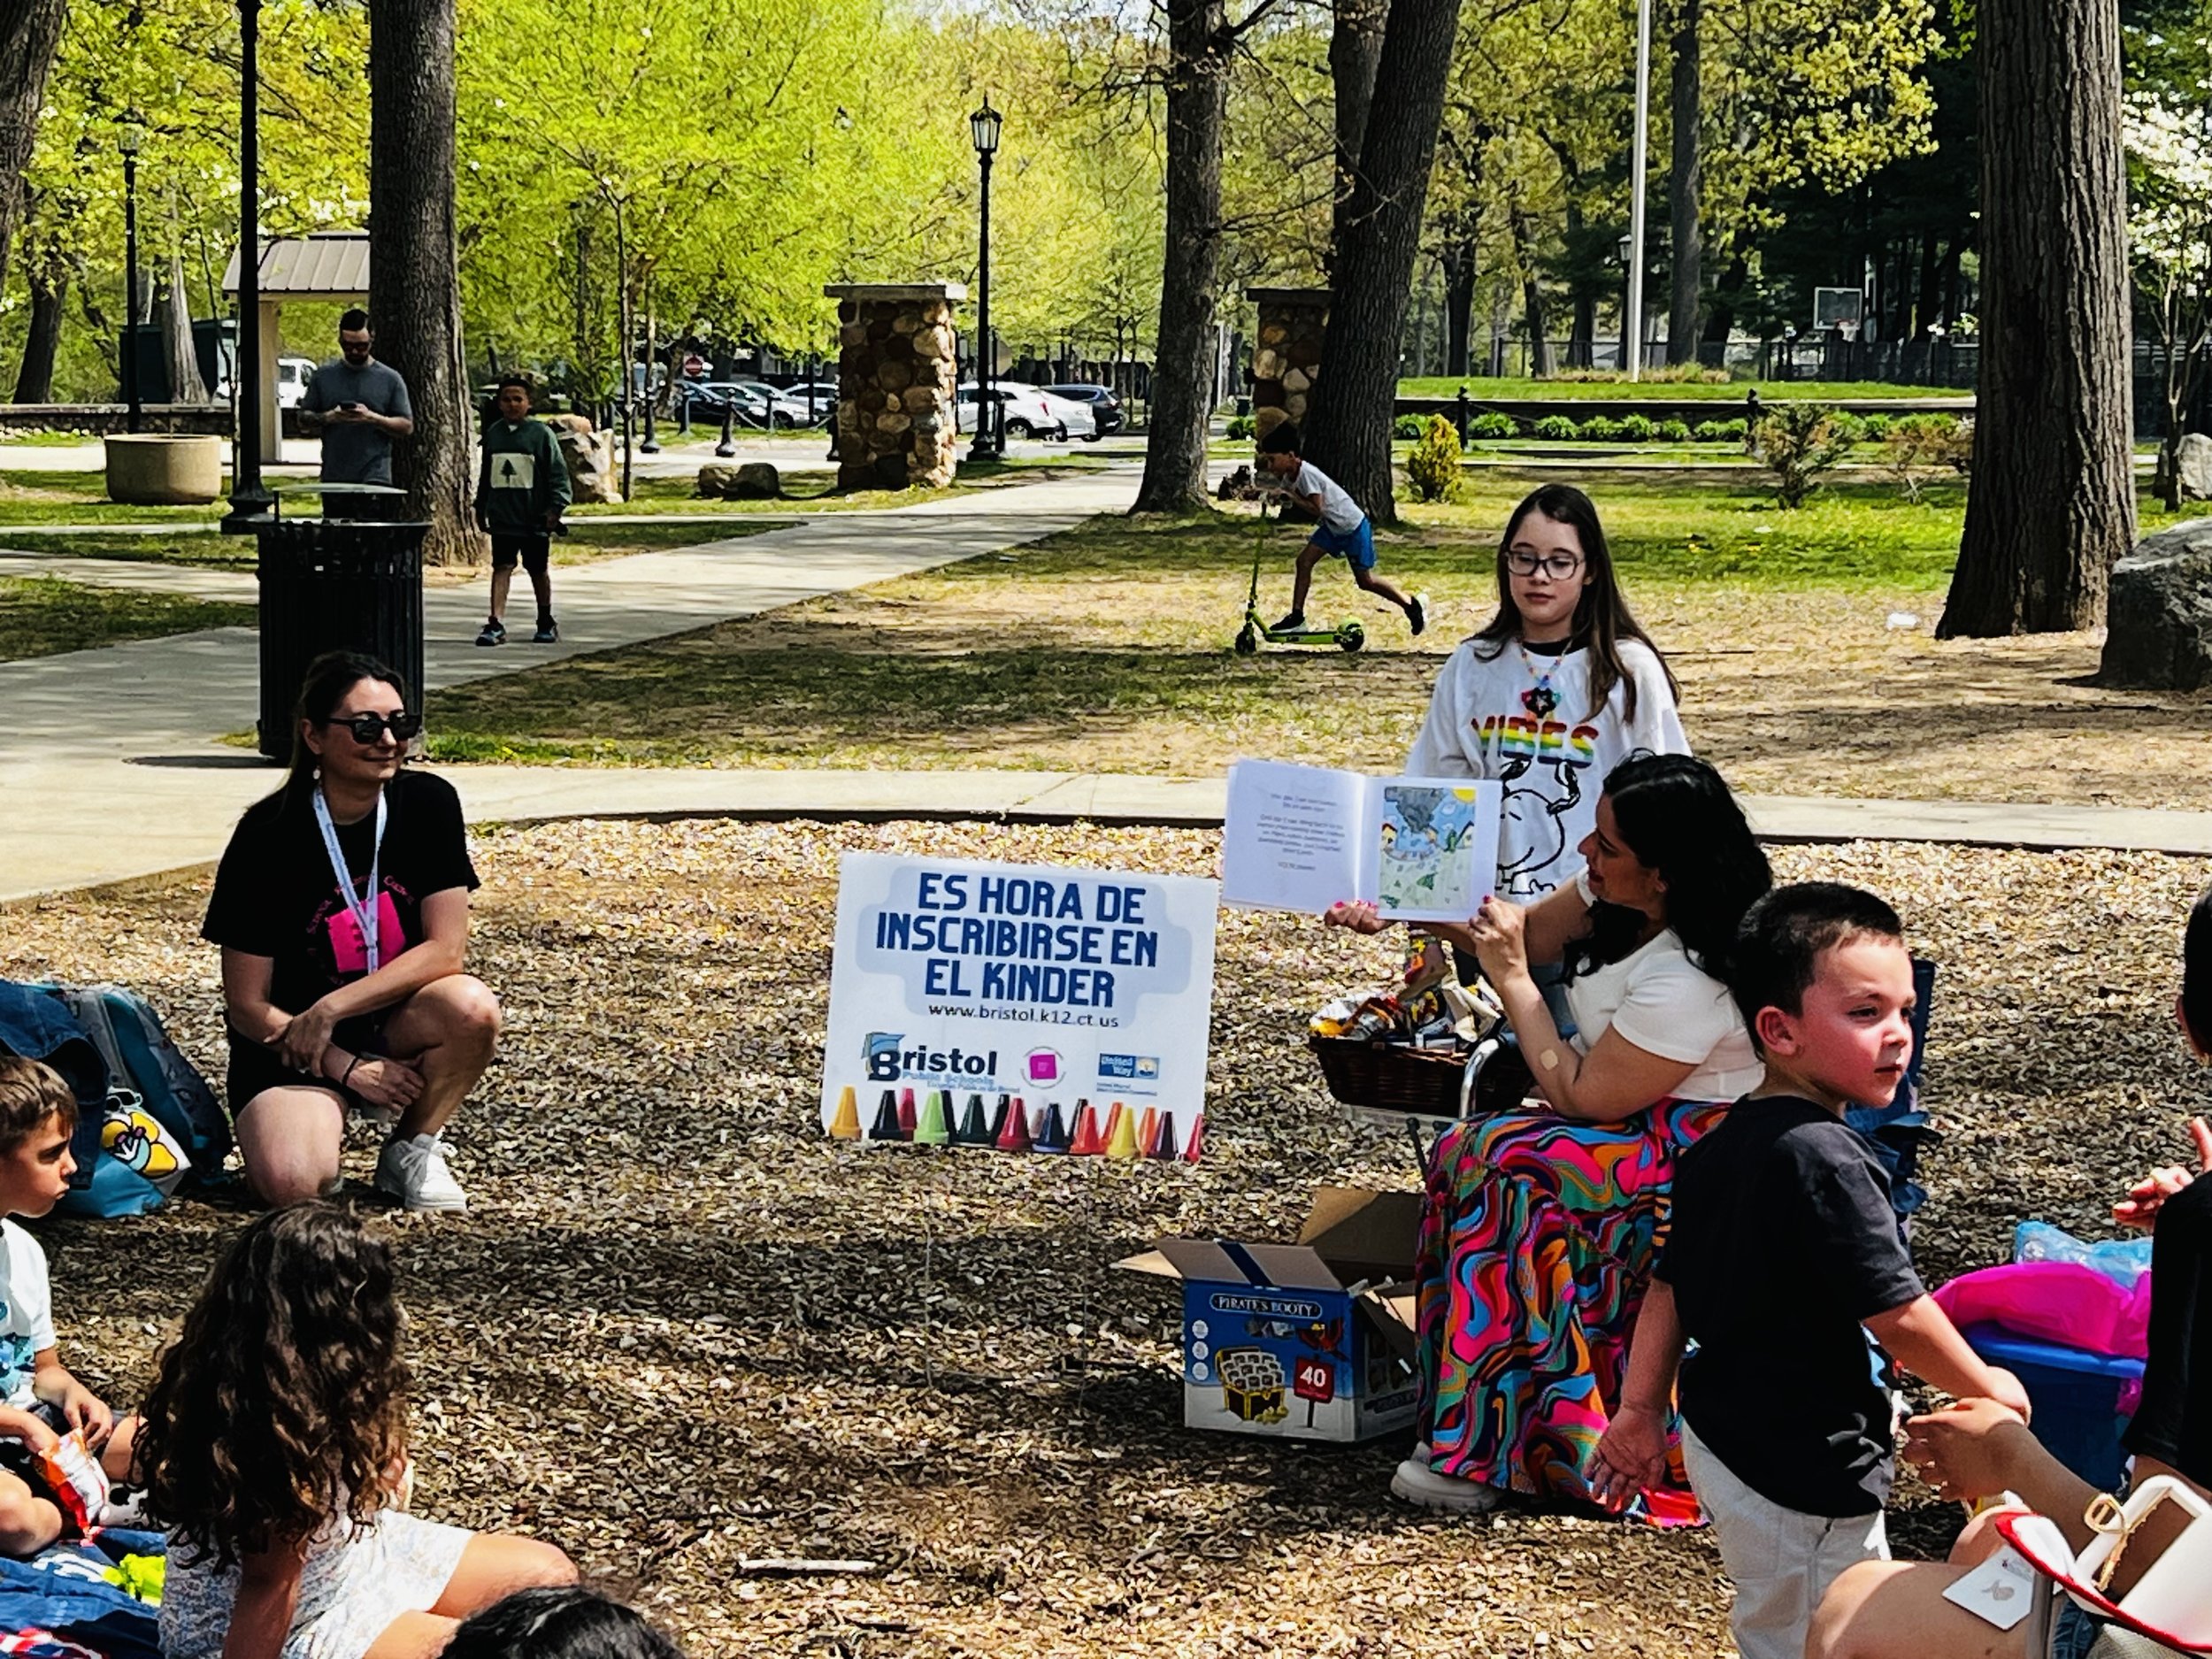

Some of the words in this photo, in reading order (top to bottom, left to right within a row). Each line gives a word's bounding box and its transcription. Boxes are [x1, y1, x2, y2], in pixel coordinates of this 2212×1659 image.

[918, 872, 968, 910] ES
[979, 877, 1084, 919] HORA
[1096, 885, 1147, 925] DE
[876, 912, 1104, 964] INSCRIBIRSE
[1110, 930, 1158, 967] EN
[925, 958, 972, 996] EL
[982, 962, 1116, 1008] KINDER
[929, 1004, 1119, 1028] www.bristol.k12.ct.us
[868, 1045, 998, 1082] Bristol
[1271, 1302, 1314, 1317] BOOTY
[1299, 1365, 1327, 1387] 40
